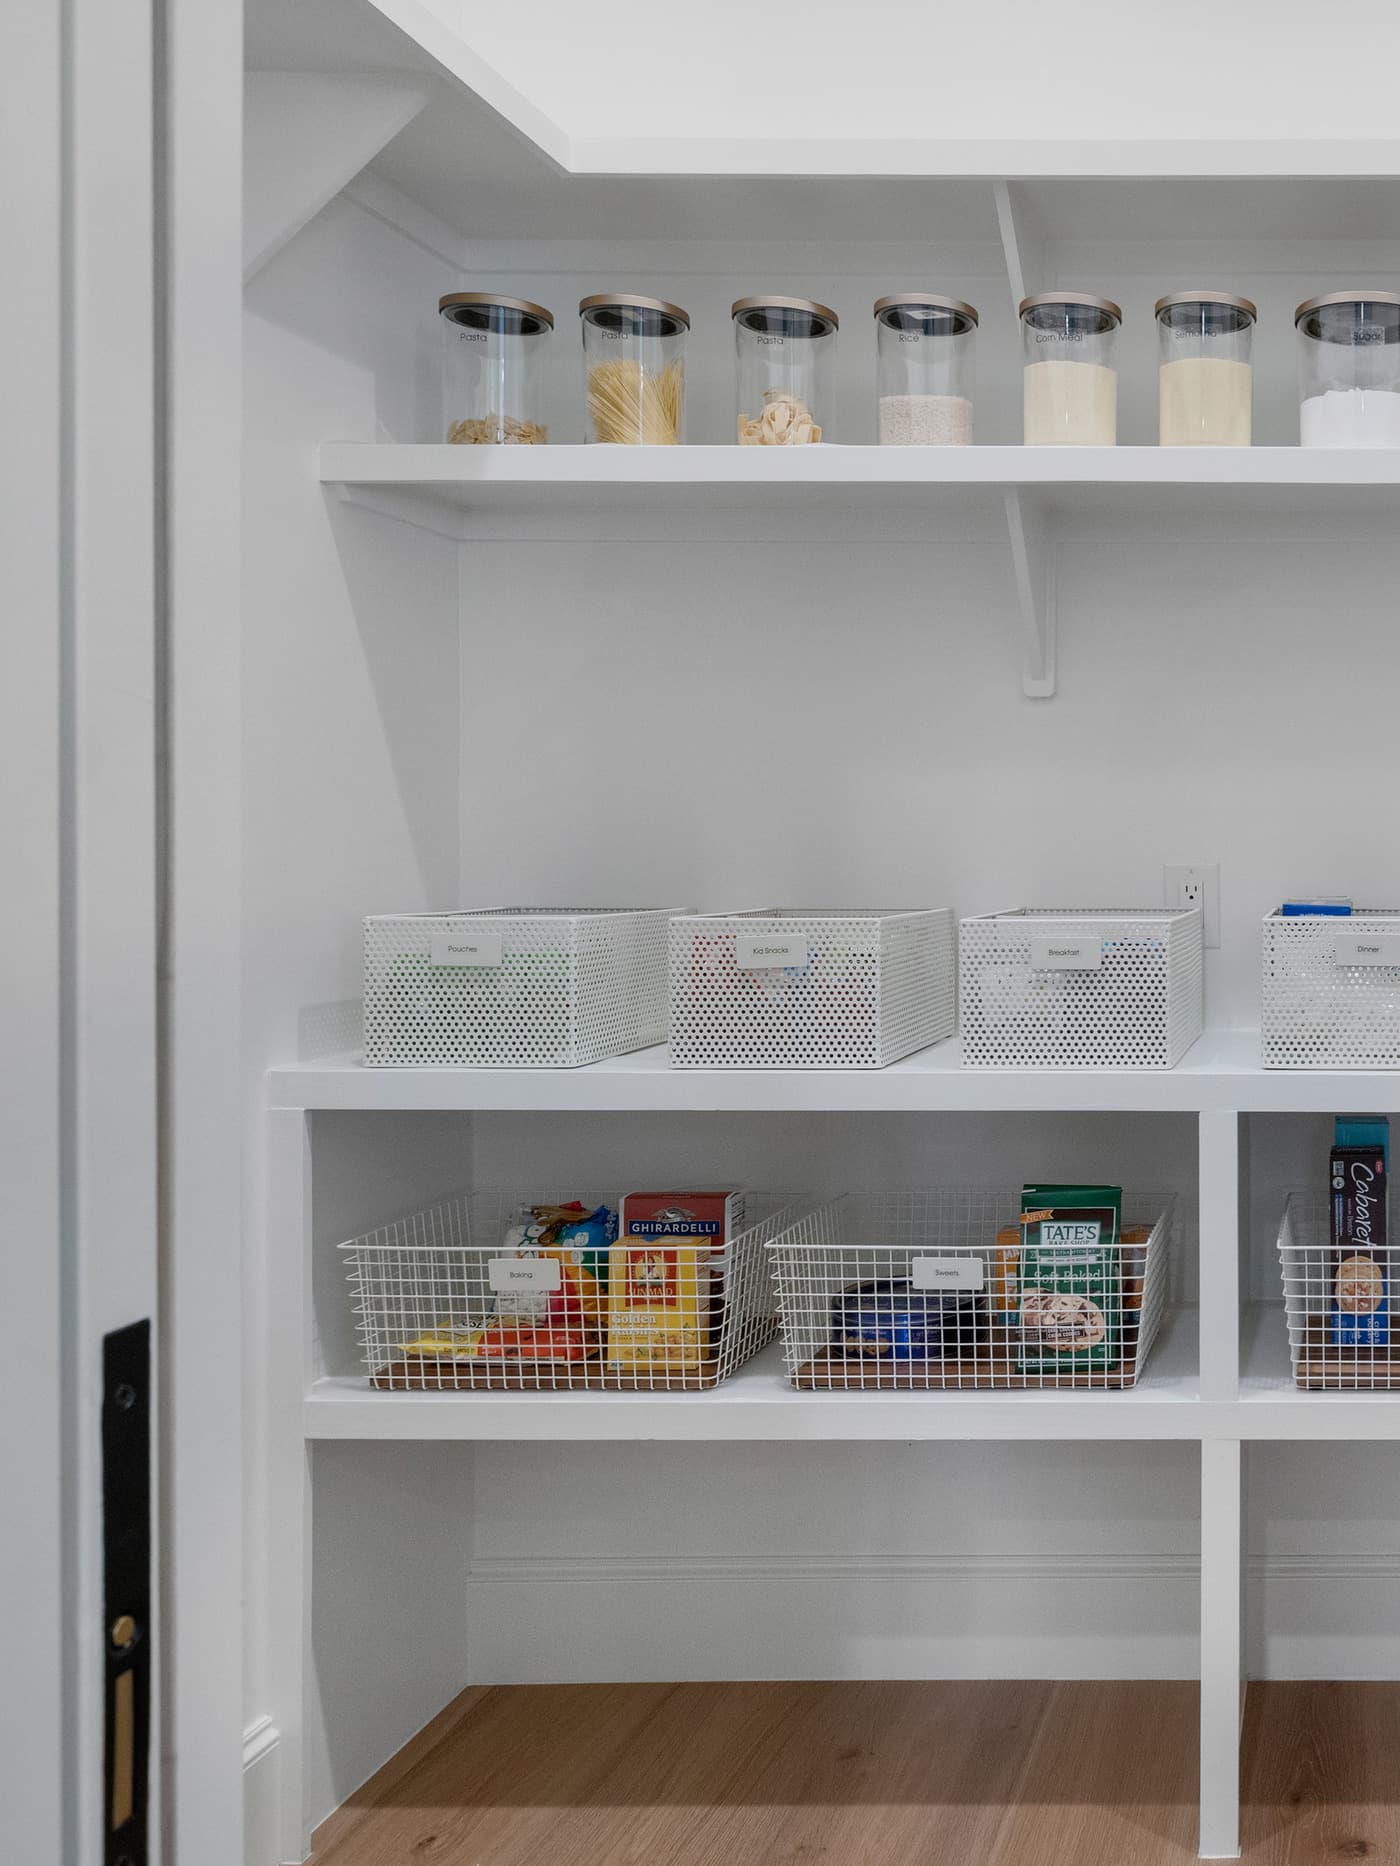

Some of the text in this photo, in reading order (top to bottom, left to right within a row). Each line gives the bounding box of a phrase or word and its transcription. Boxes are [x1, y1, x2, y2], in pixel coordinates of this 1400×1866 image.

[460, 332, 487, 343] Pasta
[601, 330, 628, 340] Pasta
[899, 333, 920, 343] Rice
[1036, 332, 1083, 344] Corn Meal
[1175, 329, 1217, 339] Semona
[1353, 330, 1382, 343] Sugar
[757, 335, 784, 345] Pasta
[447, 945, 478, 953] Pouches
[752, 946, 789, 955] Kid Snacks
[1048, 949, 1080, 957] Breakfast
[1350, 1162, 1378, 1248] Cabaret
[1026, 1210, 1046, 1221] NEW
[631, 1223, 716, 1233] GHIRARDELLI
[1043, 1225, 1097, 1240] TATE'S
[509, 1271, 533, 1280] Baking
[1033, 1269, 1101, 1284] Soft Baked
